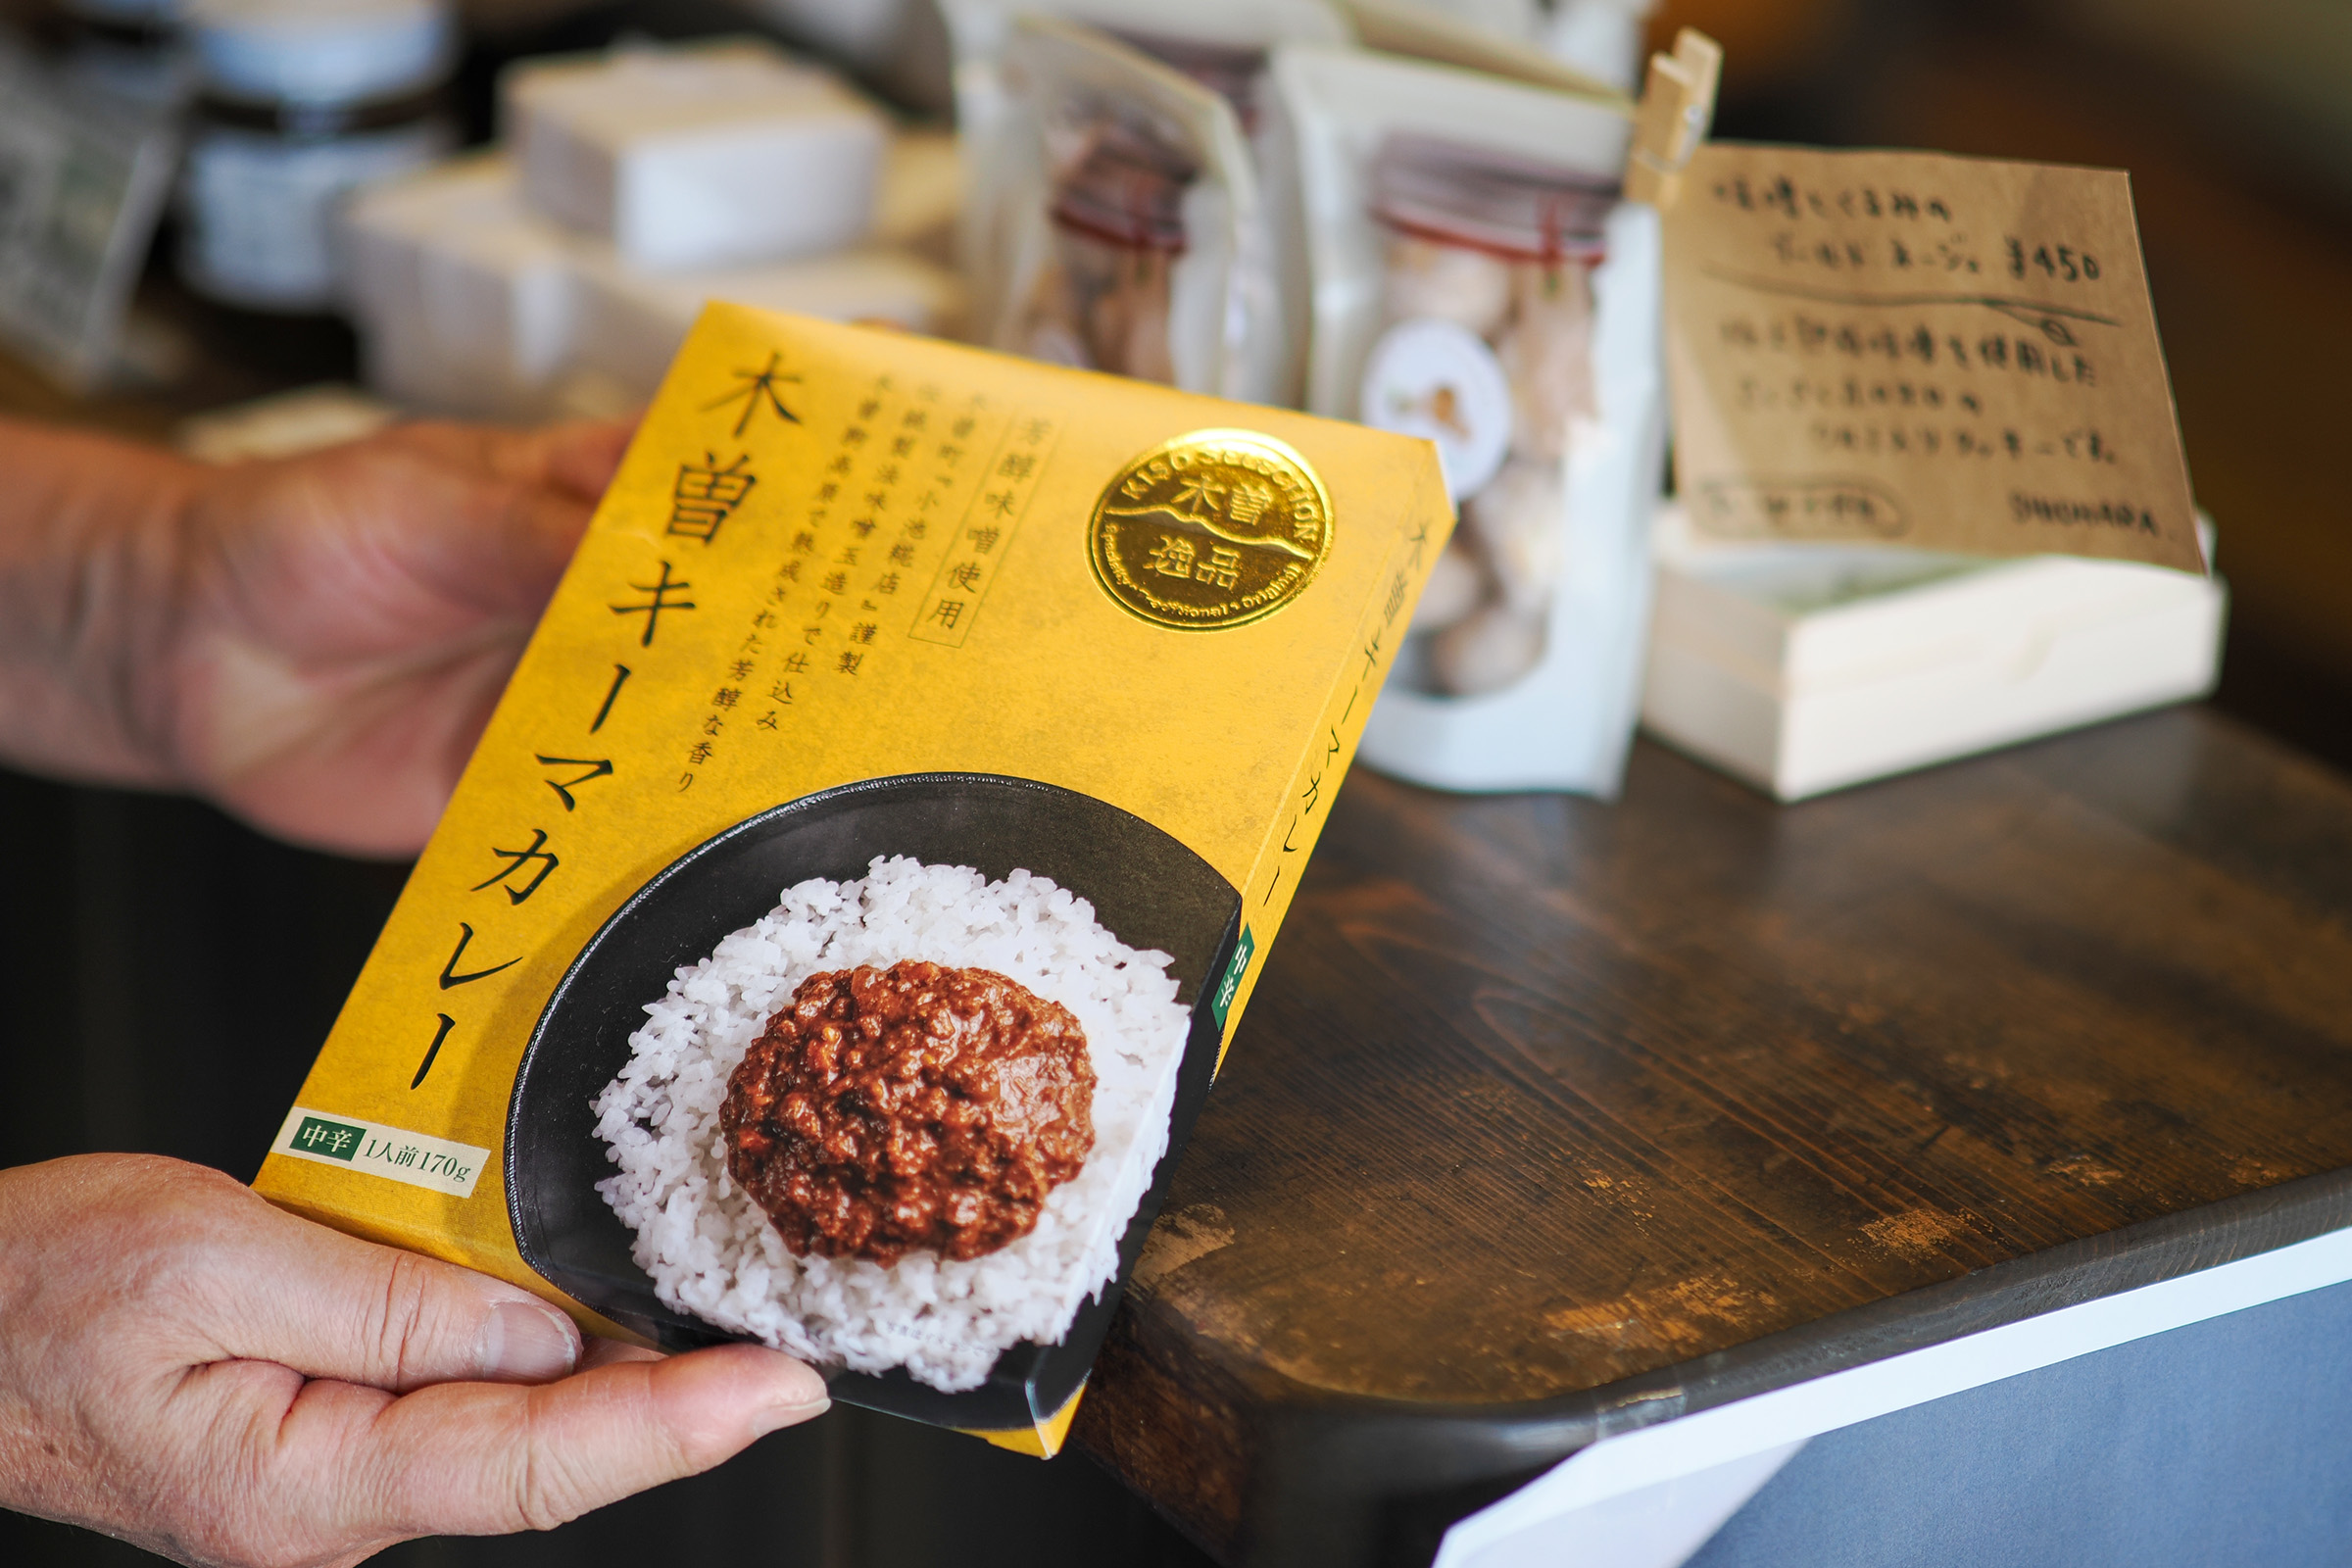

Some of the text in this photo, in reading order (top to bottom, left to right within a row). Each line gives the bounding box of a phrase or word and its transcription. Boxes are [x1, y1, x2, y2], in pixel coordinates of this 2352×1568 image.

[1120, 452, 1190, 501] KISO
[1170, 472, 1275, 526] 木曽
[927, 416, 1053, 630] 芳醇味噌使用
[1142, 534, 1242, 591] 逸品
[410, 350, 804, 1092] 木曽キーマカレー
[1262, 518, 1431, 907] 木曽キーマカレー
[1219, 943, 1248, 1007] 中辛
[301, 1124, 354, 1153] 中辛
